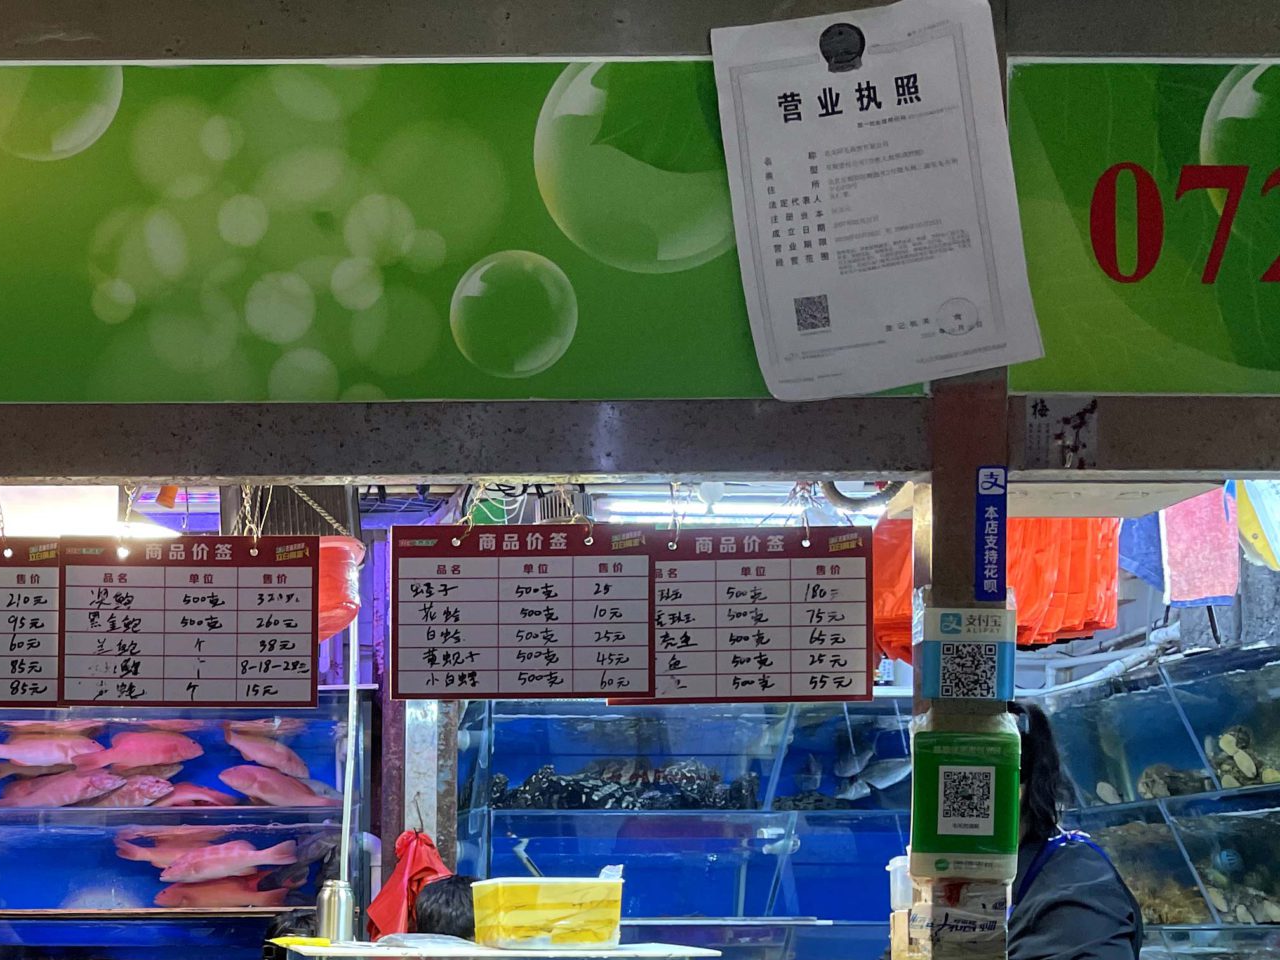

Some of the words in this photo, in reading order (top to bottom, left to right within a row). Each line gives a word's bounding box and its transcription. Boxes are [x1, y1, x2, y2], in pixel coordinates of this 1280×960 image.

[777, 73, 922, 124] 营业执照
[772, 223, 826, 239] 成立日期
[479, 532, 568, 551] 商品价签
[695, 534, 785, 554] 商品价签
[983, 505, 1000, 593] 本店支持花呗
[144, 542, 232, 561] 商品价签
[436, 564, 461, 575] 品名
[523, 562, 548, 574] 单位
[598, 562, 623, 574] 售价
[655, 567, 678, 579] 品名
[740, 565, 766, 577] 单位
[816, 564, 841, 576] 售价
[16, 573, 40, 585] 售价
[103, 572, 128, 583] 品名
[189, 572, 214, 584] 单位
[262, 572, 287, 585] 售价
[515, 583, 558, 599] 500克
[593, 583, 612, 596] 25
[726, 586, 767, 604] 500克
[6, 593, 47, 608] 210元
[183, 592, 225, 607] 500克
[519, 605, 559, 622] 500克
[593, 604, 623, 619] 10元
[727, 608, 769, 625] 500克
[806, 608, 845, 624] 75元
[8, 615, 44, 631] 95元
[180, 615, 223, 631] 500克
[256, 614, 297, 629] 260元
[965, 614, 1002, 627] 支付宝
[9, 634, 40, 651] 60元
[516, 627, 559, 645] 500克
[594, 631, 626, 644] 25元
[728, 630, 771, 647] 500克
[808, 627, 846, 645] 65元
[259, 638, 295, 653] 38元
[516, 649, 560, 666] 500克
[596, 652, 630, 666] 45元
[731, 651, 773, 668] 500克
[809, 653, 847, 668] 25元
[10, 658, 42, 674] 85元
[517, 671, 565, 688] 500克
[600, 669, 630, 689] 60元
[732, 674, 775, 691] 500克
[809, 673, 853, 689] 55元
[9, 679, 48, 696] 85元
[246, 683, 278, 698] 15元
